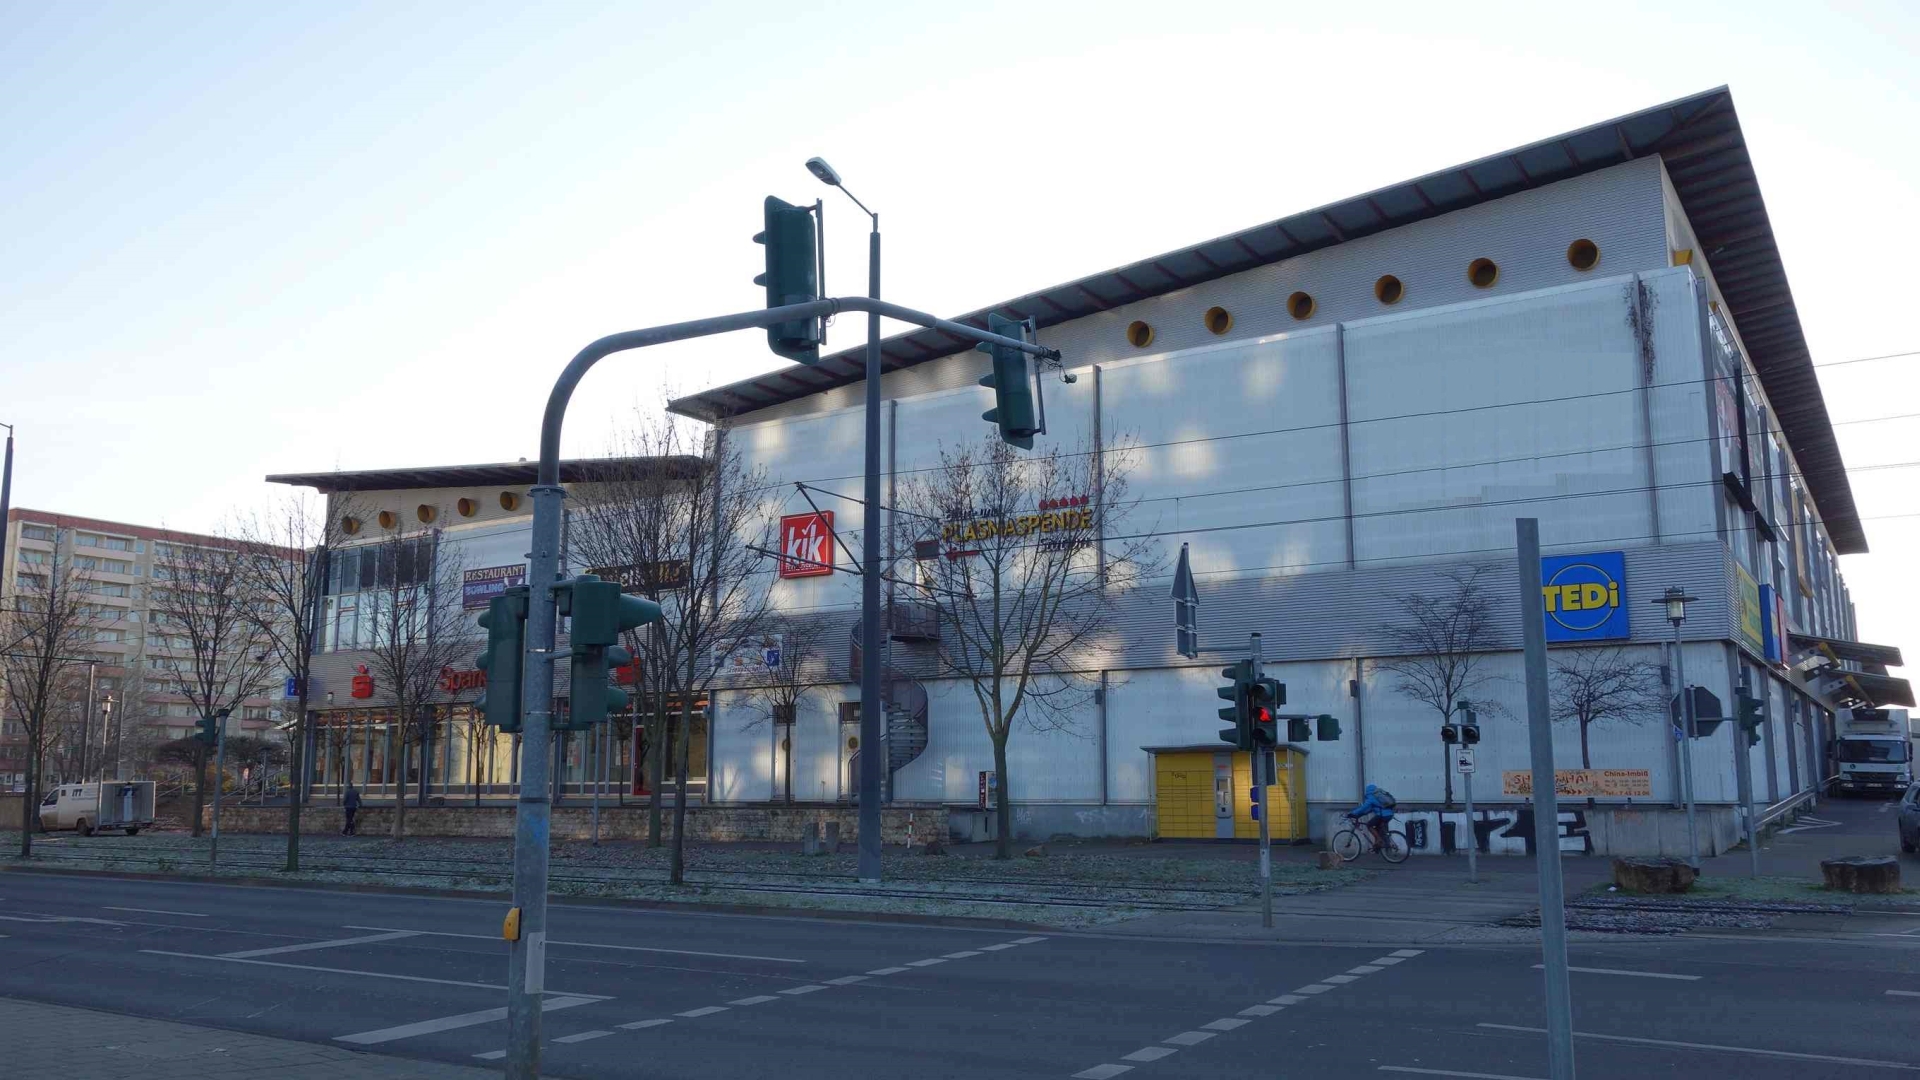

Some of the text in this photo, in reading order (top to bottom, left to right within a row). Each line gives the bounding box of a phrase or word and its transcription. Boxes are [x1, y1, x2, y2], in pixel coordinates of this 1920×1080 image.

[942, 508, 1092, 543] PLASMASPENDE
[465, 565, 526, 581] RESTAURANT
[465, 582, 504, 596] BOWLING
[1541, 581, 1619, 612] TEDi
